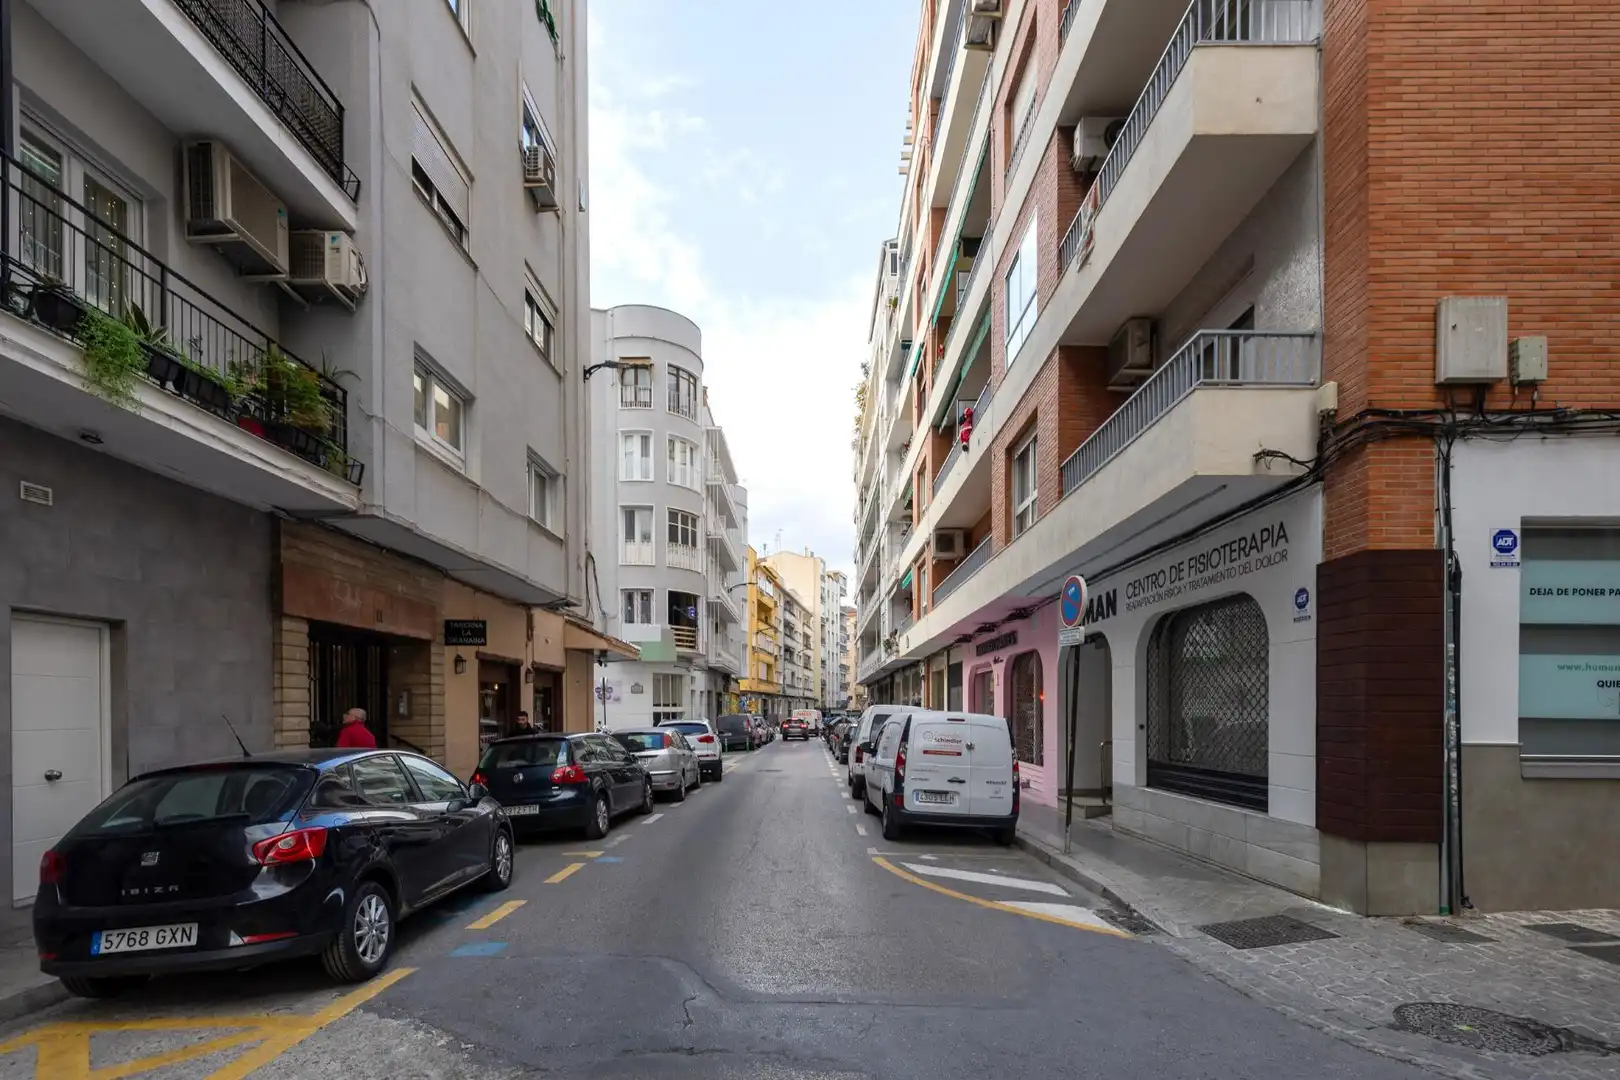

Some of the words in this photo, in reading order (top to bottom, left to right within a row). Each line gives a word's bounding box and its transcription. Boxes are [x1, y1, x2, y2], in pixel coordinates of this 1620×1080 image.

[1496, 537, 1514, 546] ADT
[1125, 569, 1167, 600] CENTRO
[1169, 561, 1185, 584] DE
[1187, 521, 1289, 578] FISIOTERAPIA
[1183, 583, 1189, 593] Y
[1188, 566, 1237, 591] TRATAMIENTO
[1238, 562, 1254, 576] DEL
[1255, 549, 1288, 570] DOLOR
[1529, 587, 1554, 596] DEJA
[1556, 587, 1569, 596] DE
[1572, 587, 1606, 597] PONER
[1608, 588, 1620, 597] PA
[1082, 588, 1117, 626] MAN
[1597, 680, 1620, 689] QUIE
[121, 885, 179, 896] IBIZA
[104, 930, 149, 950] 5768
[155, 926, 193, 945] GXN
